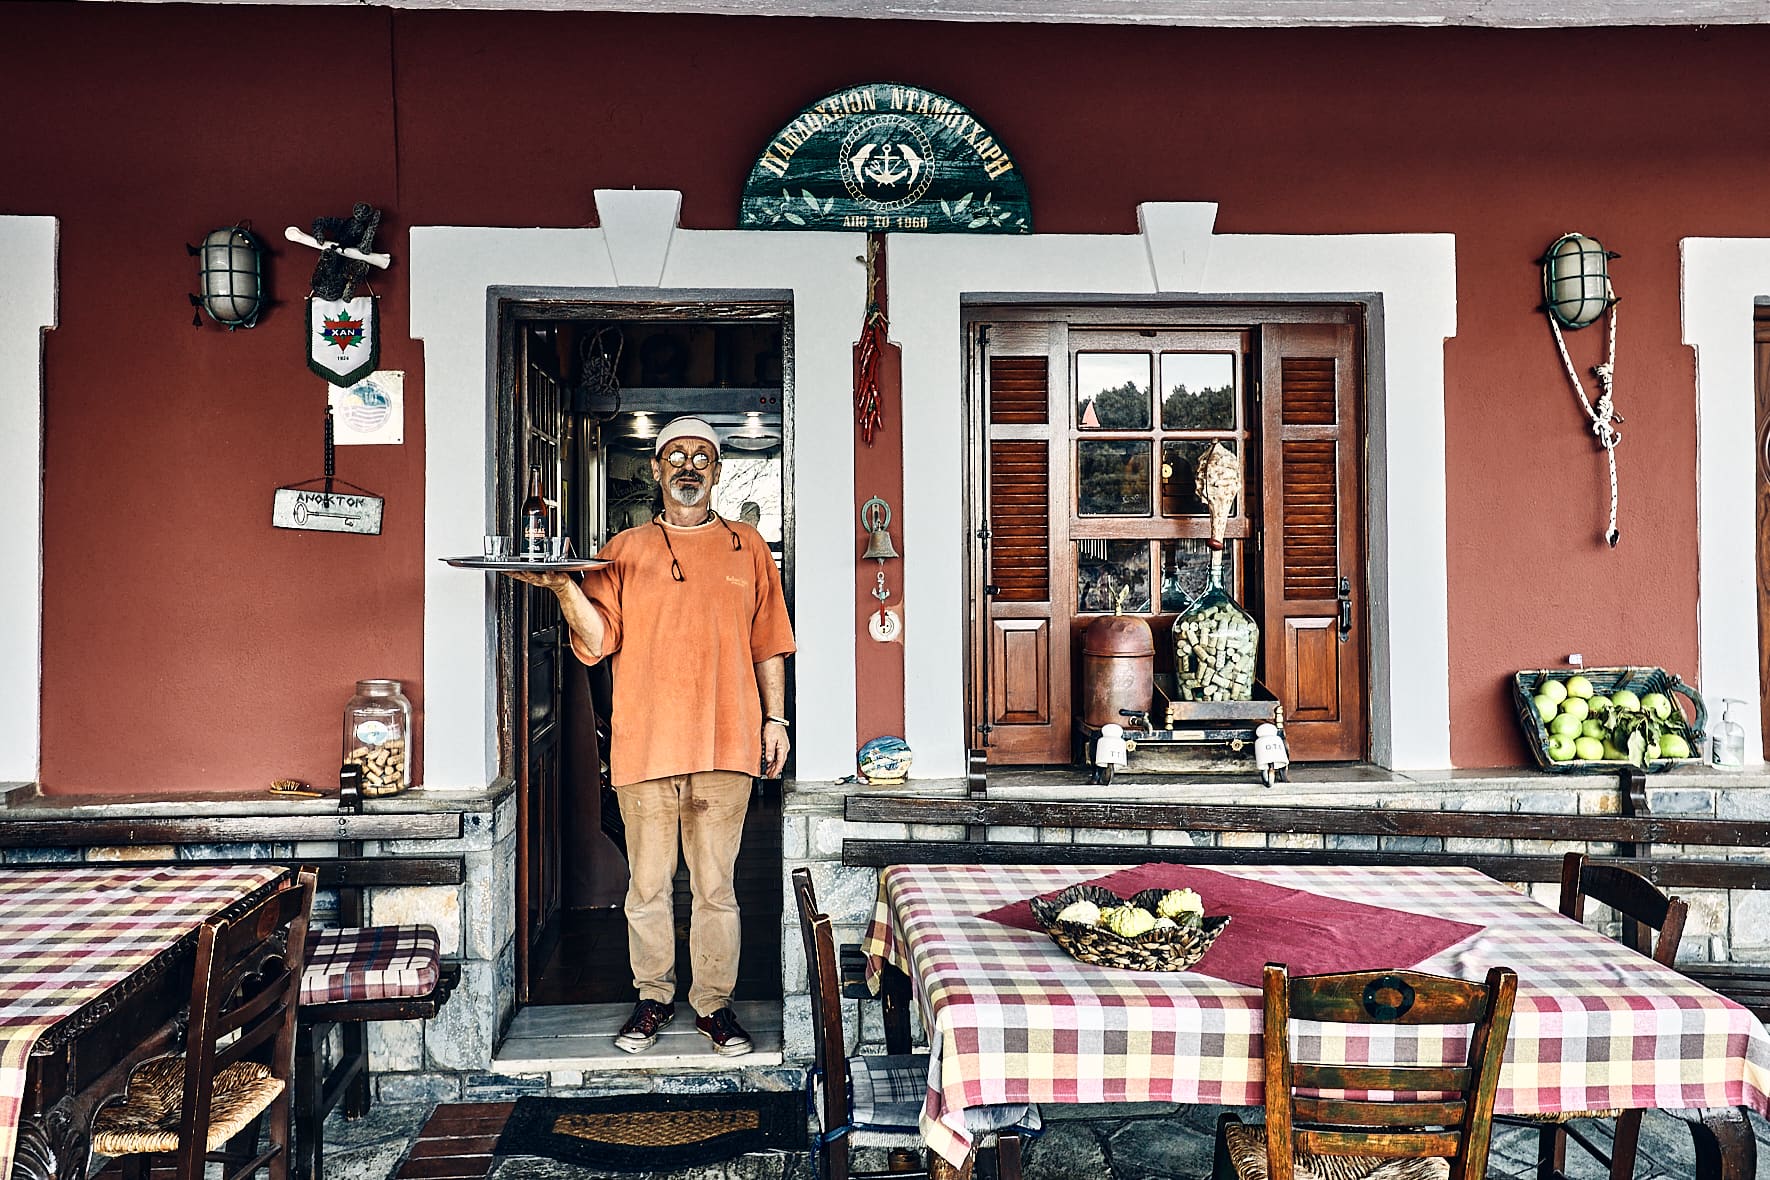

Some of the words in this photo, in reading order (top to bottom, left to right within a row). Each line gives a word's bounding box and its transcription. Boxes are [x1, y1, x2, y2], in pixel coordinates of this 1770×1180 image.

[760, 89, 876, 178] ΠΑΝΔΟΧΕΙΟΝ
[890, 88, 1013, 180] ΝΤΑΜΟΥΧΑΡΗ
[843, 216, 868, 228] ΑΠΟ
[873, 216, 890, 228] ΤΟ
